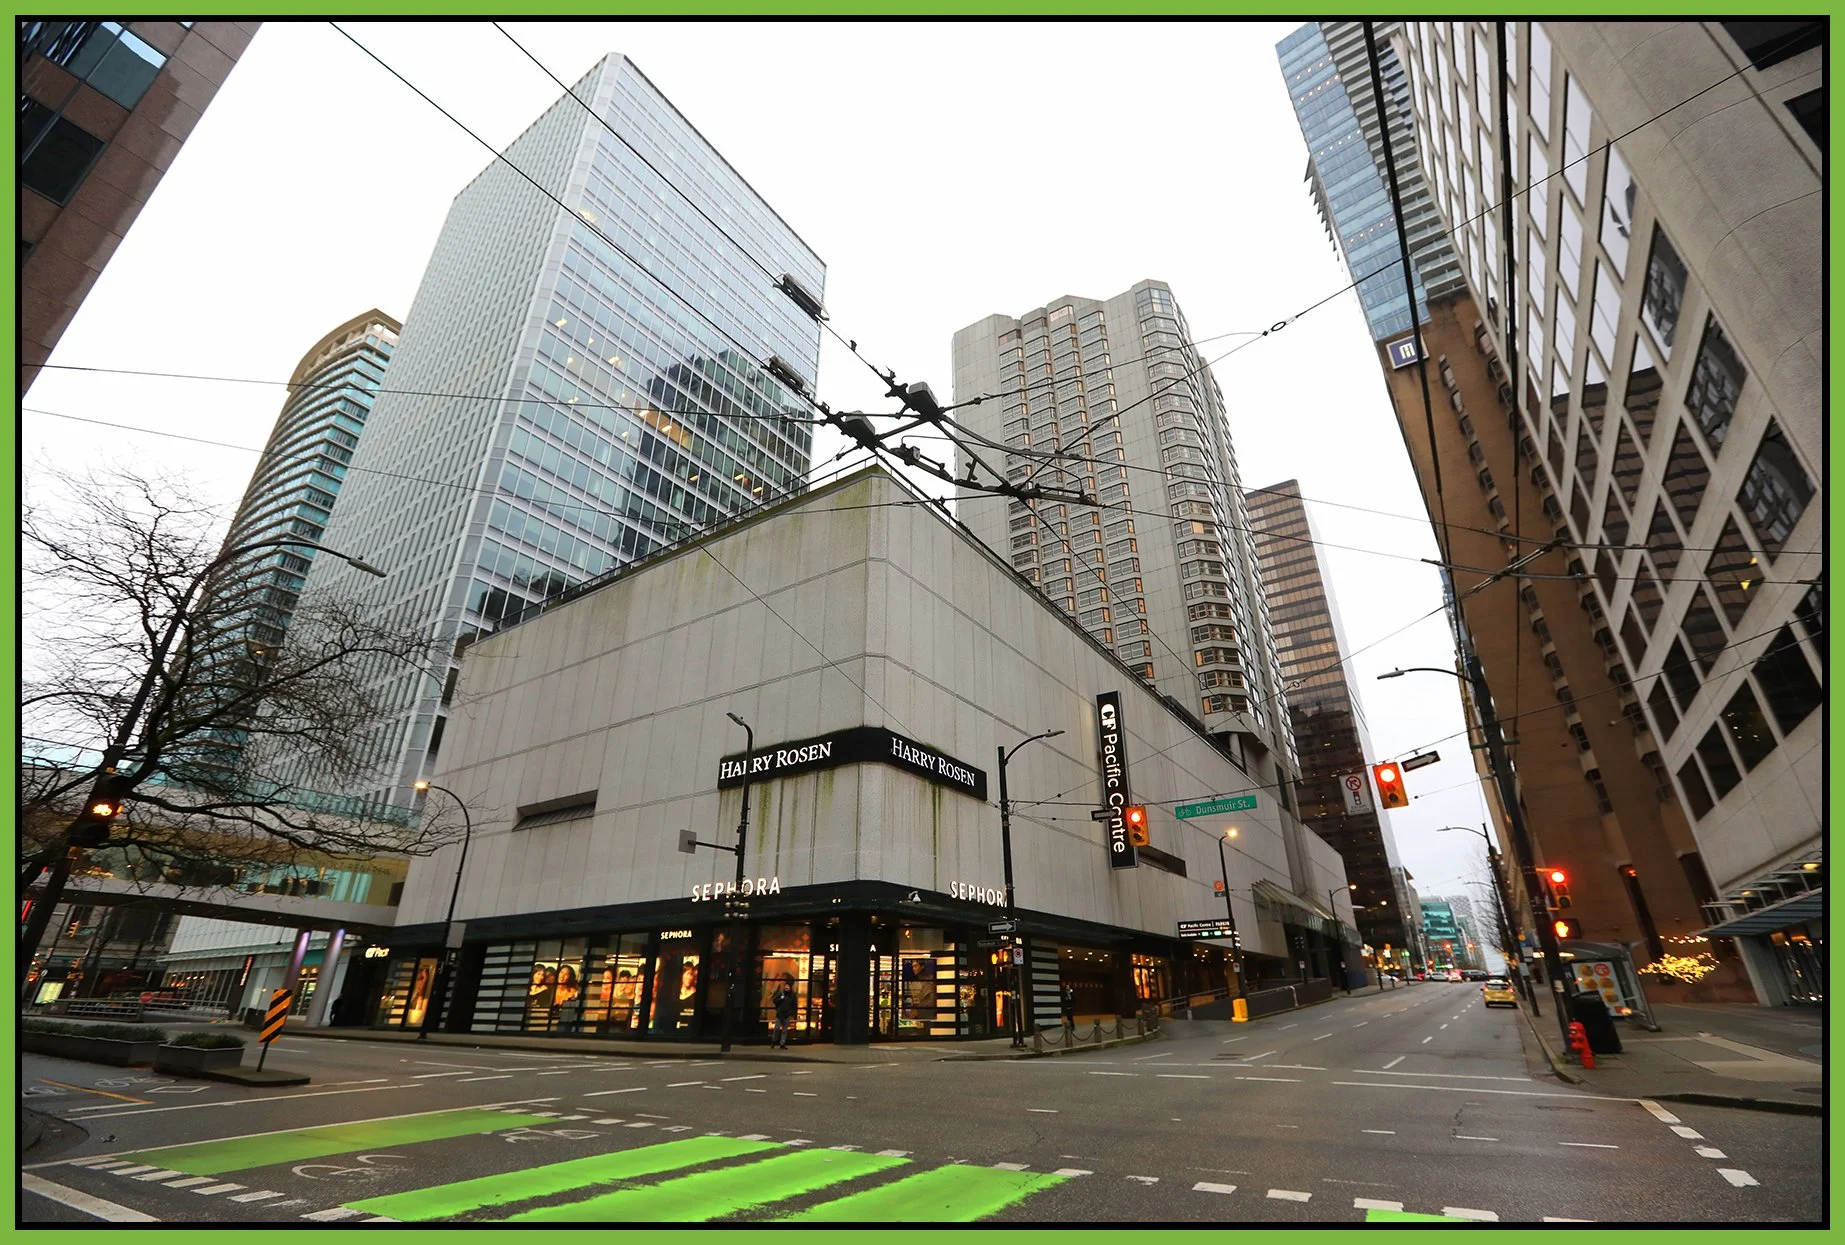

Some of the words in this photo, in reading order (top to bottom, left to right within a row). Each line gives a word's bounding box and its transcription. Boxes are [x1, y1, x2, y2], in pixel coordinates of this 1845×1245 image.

[1101, 703, 1117, 731] CF
[776, 742, 832, 768] ROSEN
[892, 737, 935, 770] HARRY
[938, 757, 975, 787] ROSEN
[1103, 733, 1122, 788] Pacific
[1196, 801, 1236, 814] Dunsmuir
[1238, 799, 1250, 809] St.
[691, 876, 780, 903] SEPHORA
[660, 930, 692, 940] SEPHORA
